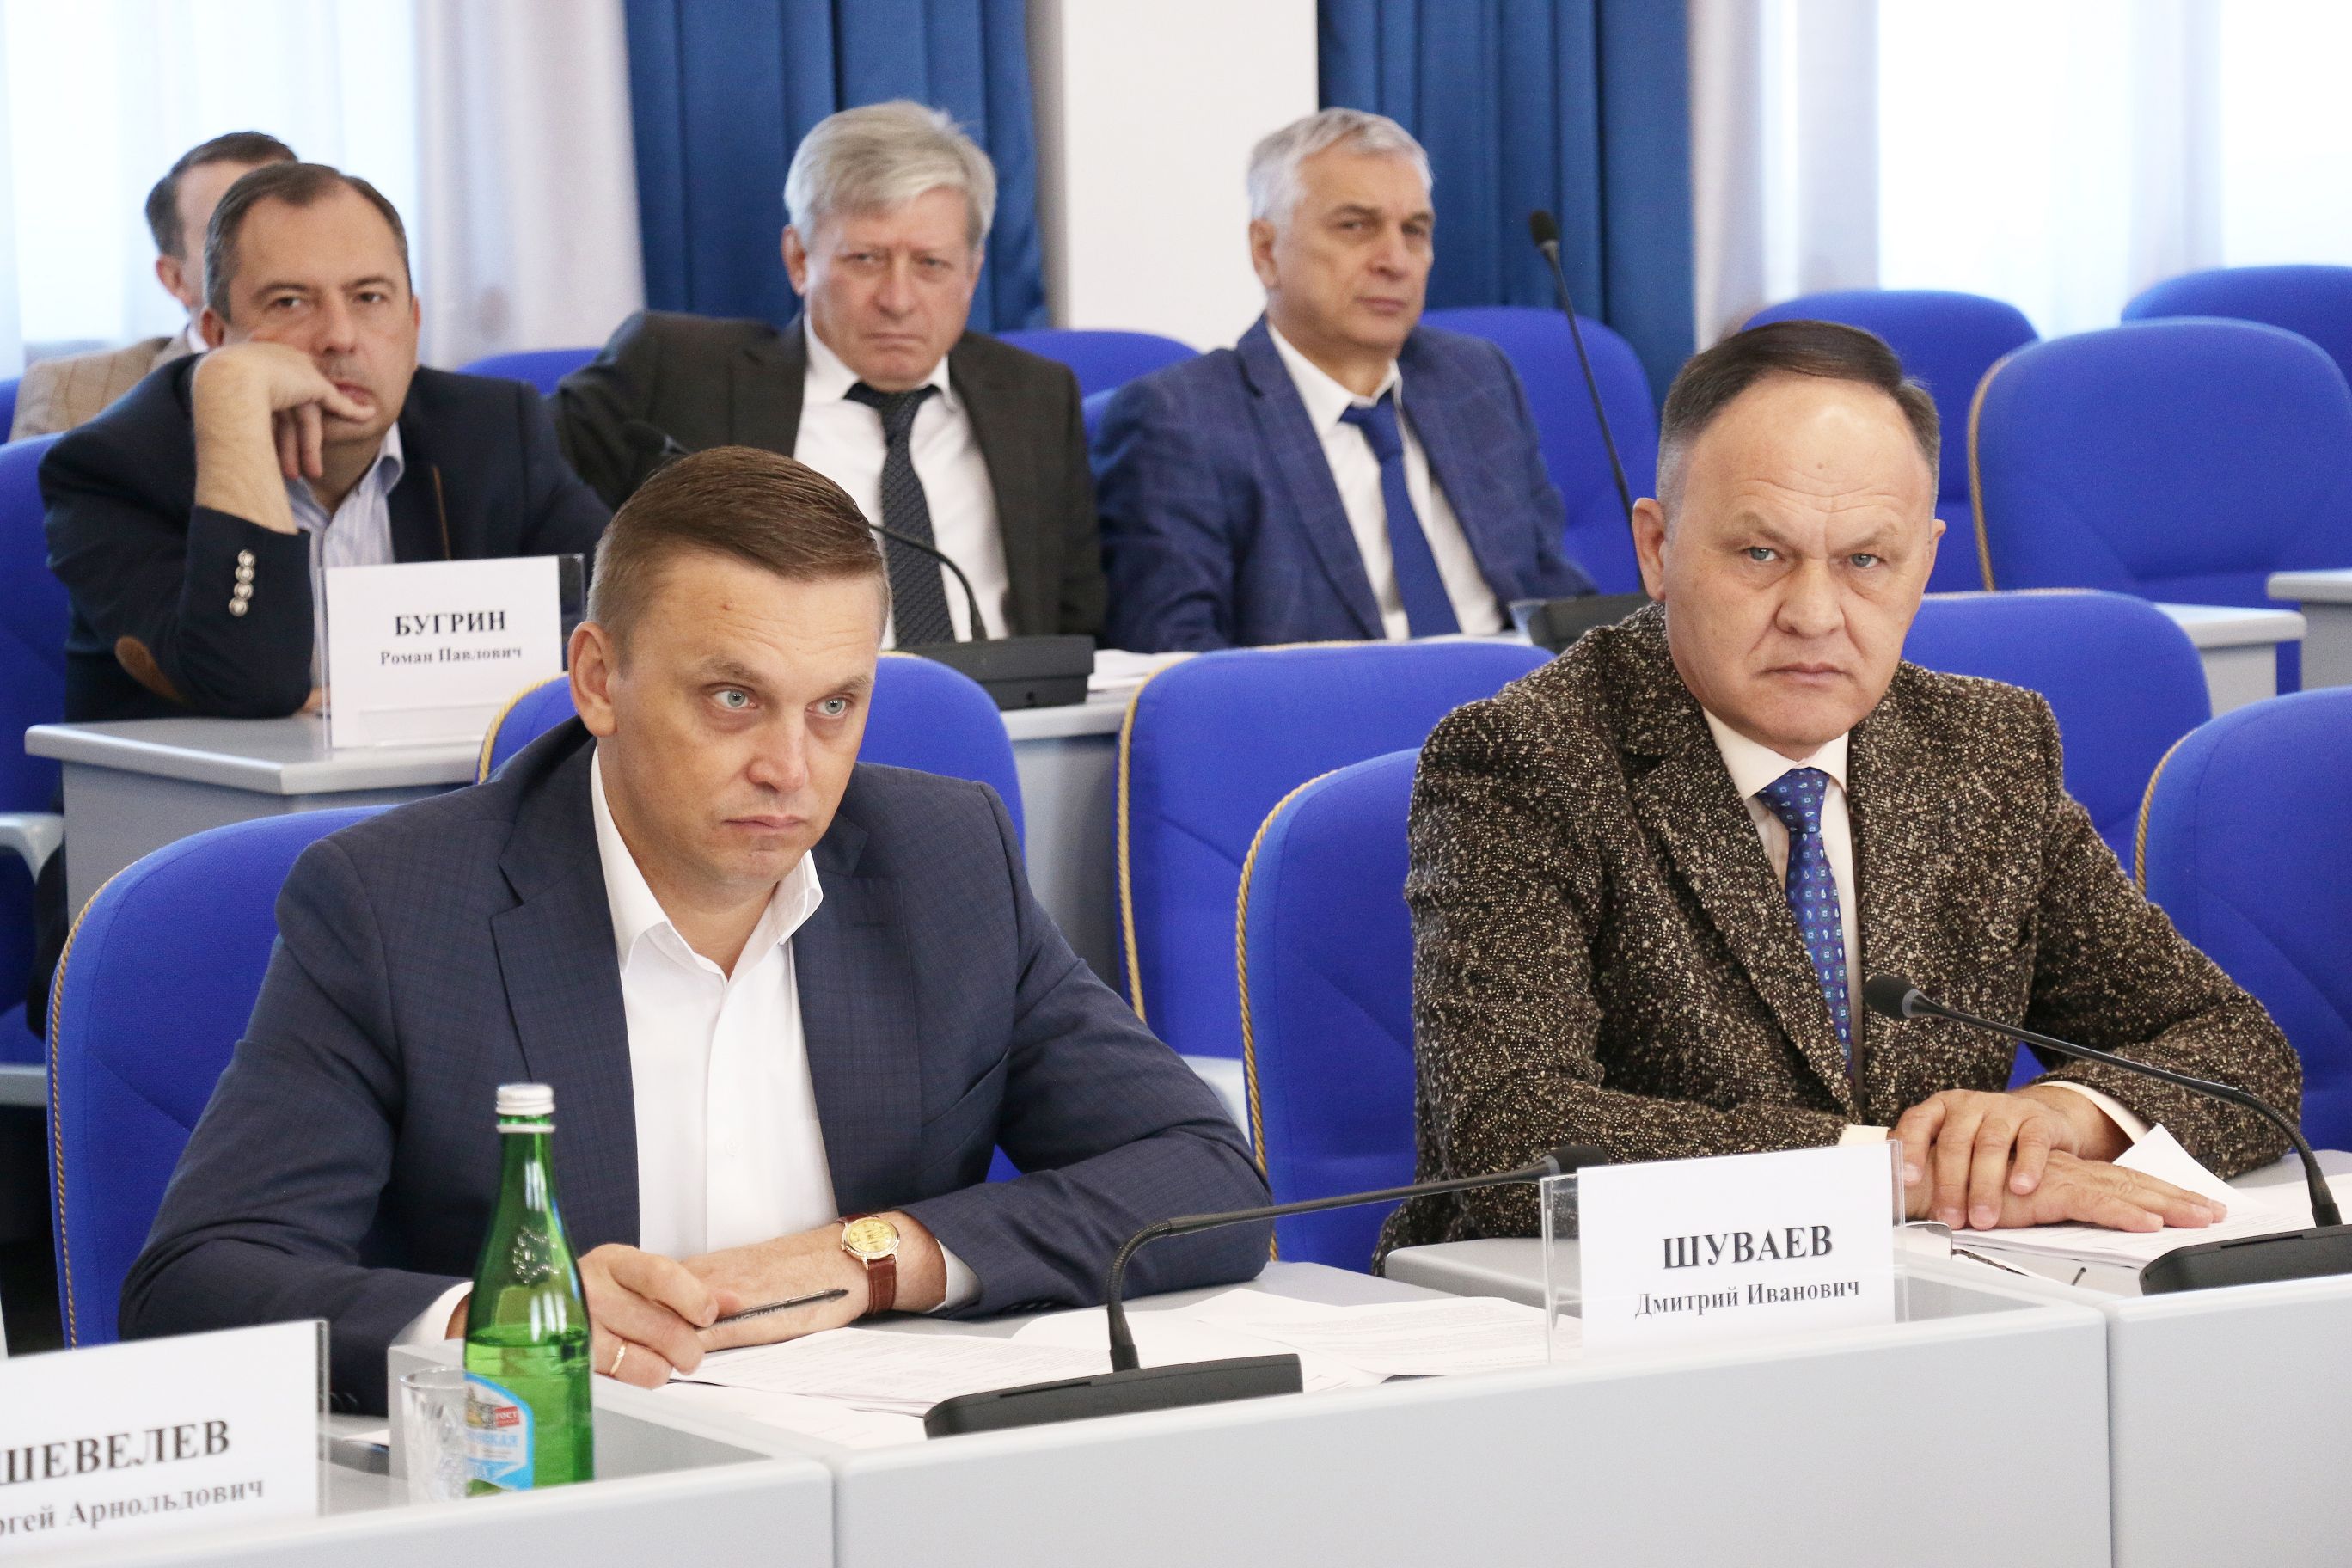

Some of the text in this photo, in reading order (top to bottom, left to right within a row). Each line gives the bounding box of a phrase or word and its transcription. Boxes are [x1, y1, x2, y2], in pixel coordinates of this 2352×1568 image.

[395, 609, 505, 637] БУГРИН
[381, 647, 522, 665] Роман Павлович
[1663, 1224, 1833, 1270] ШУВАЕВ
[1635, 1280, 1860, 1320] Дмитрий Иванович
[66, 1479, 265, 1529] Арнольдович
